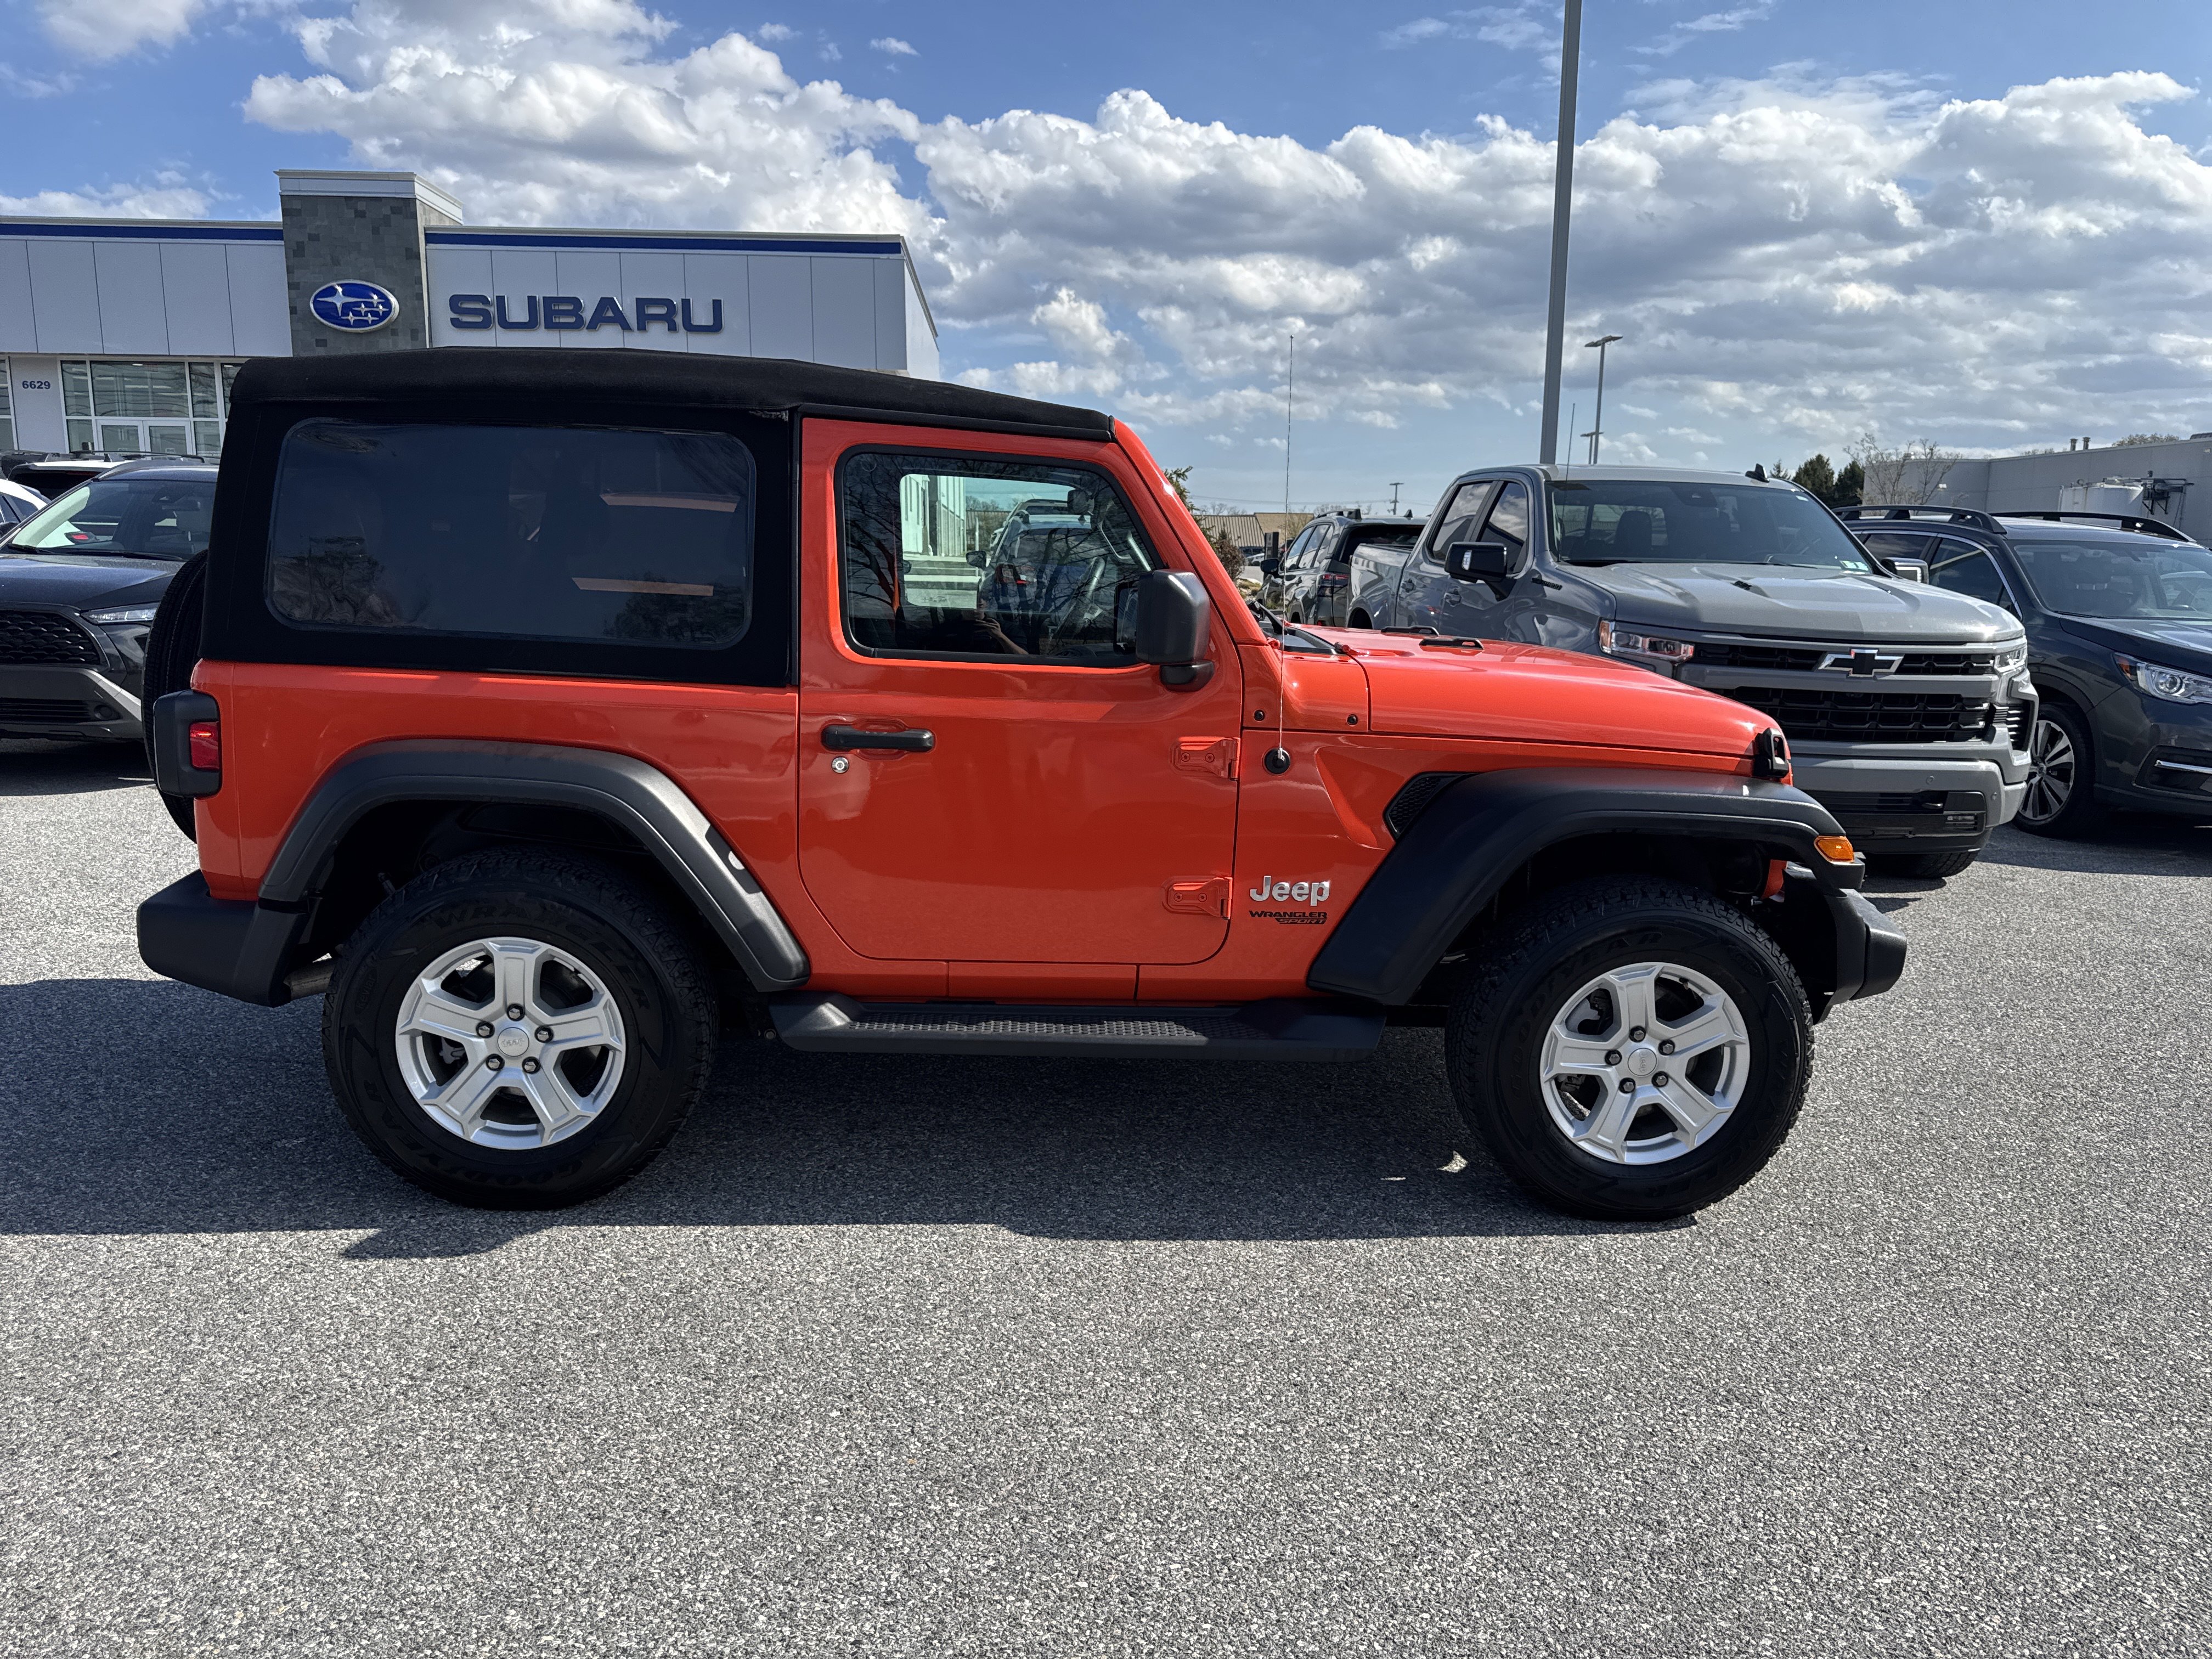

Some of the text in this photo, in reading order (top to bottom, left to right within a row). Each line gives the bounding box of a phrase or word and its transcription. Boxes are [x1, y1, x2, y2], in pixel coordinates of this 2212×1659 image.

[448, 293, 724, 334] SUBARU
[22, 381, 50, 390] 6629
[1249, 875, 1331, 907] Jeep
[1249, 910, 1328, 918] WRANGLER
[355, 973, 376, 1010] Kevlar
[1639, 1051, 1650, 1073] Jeep
